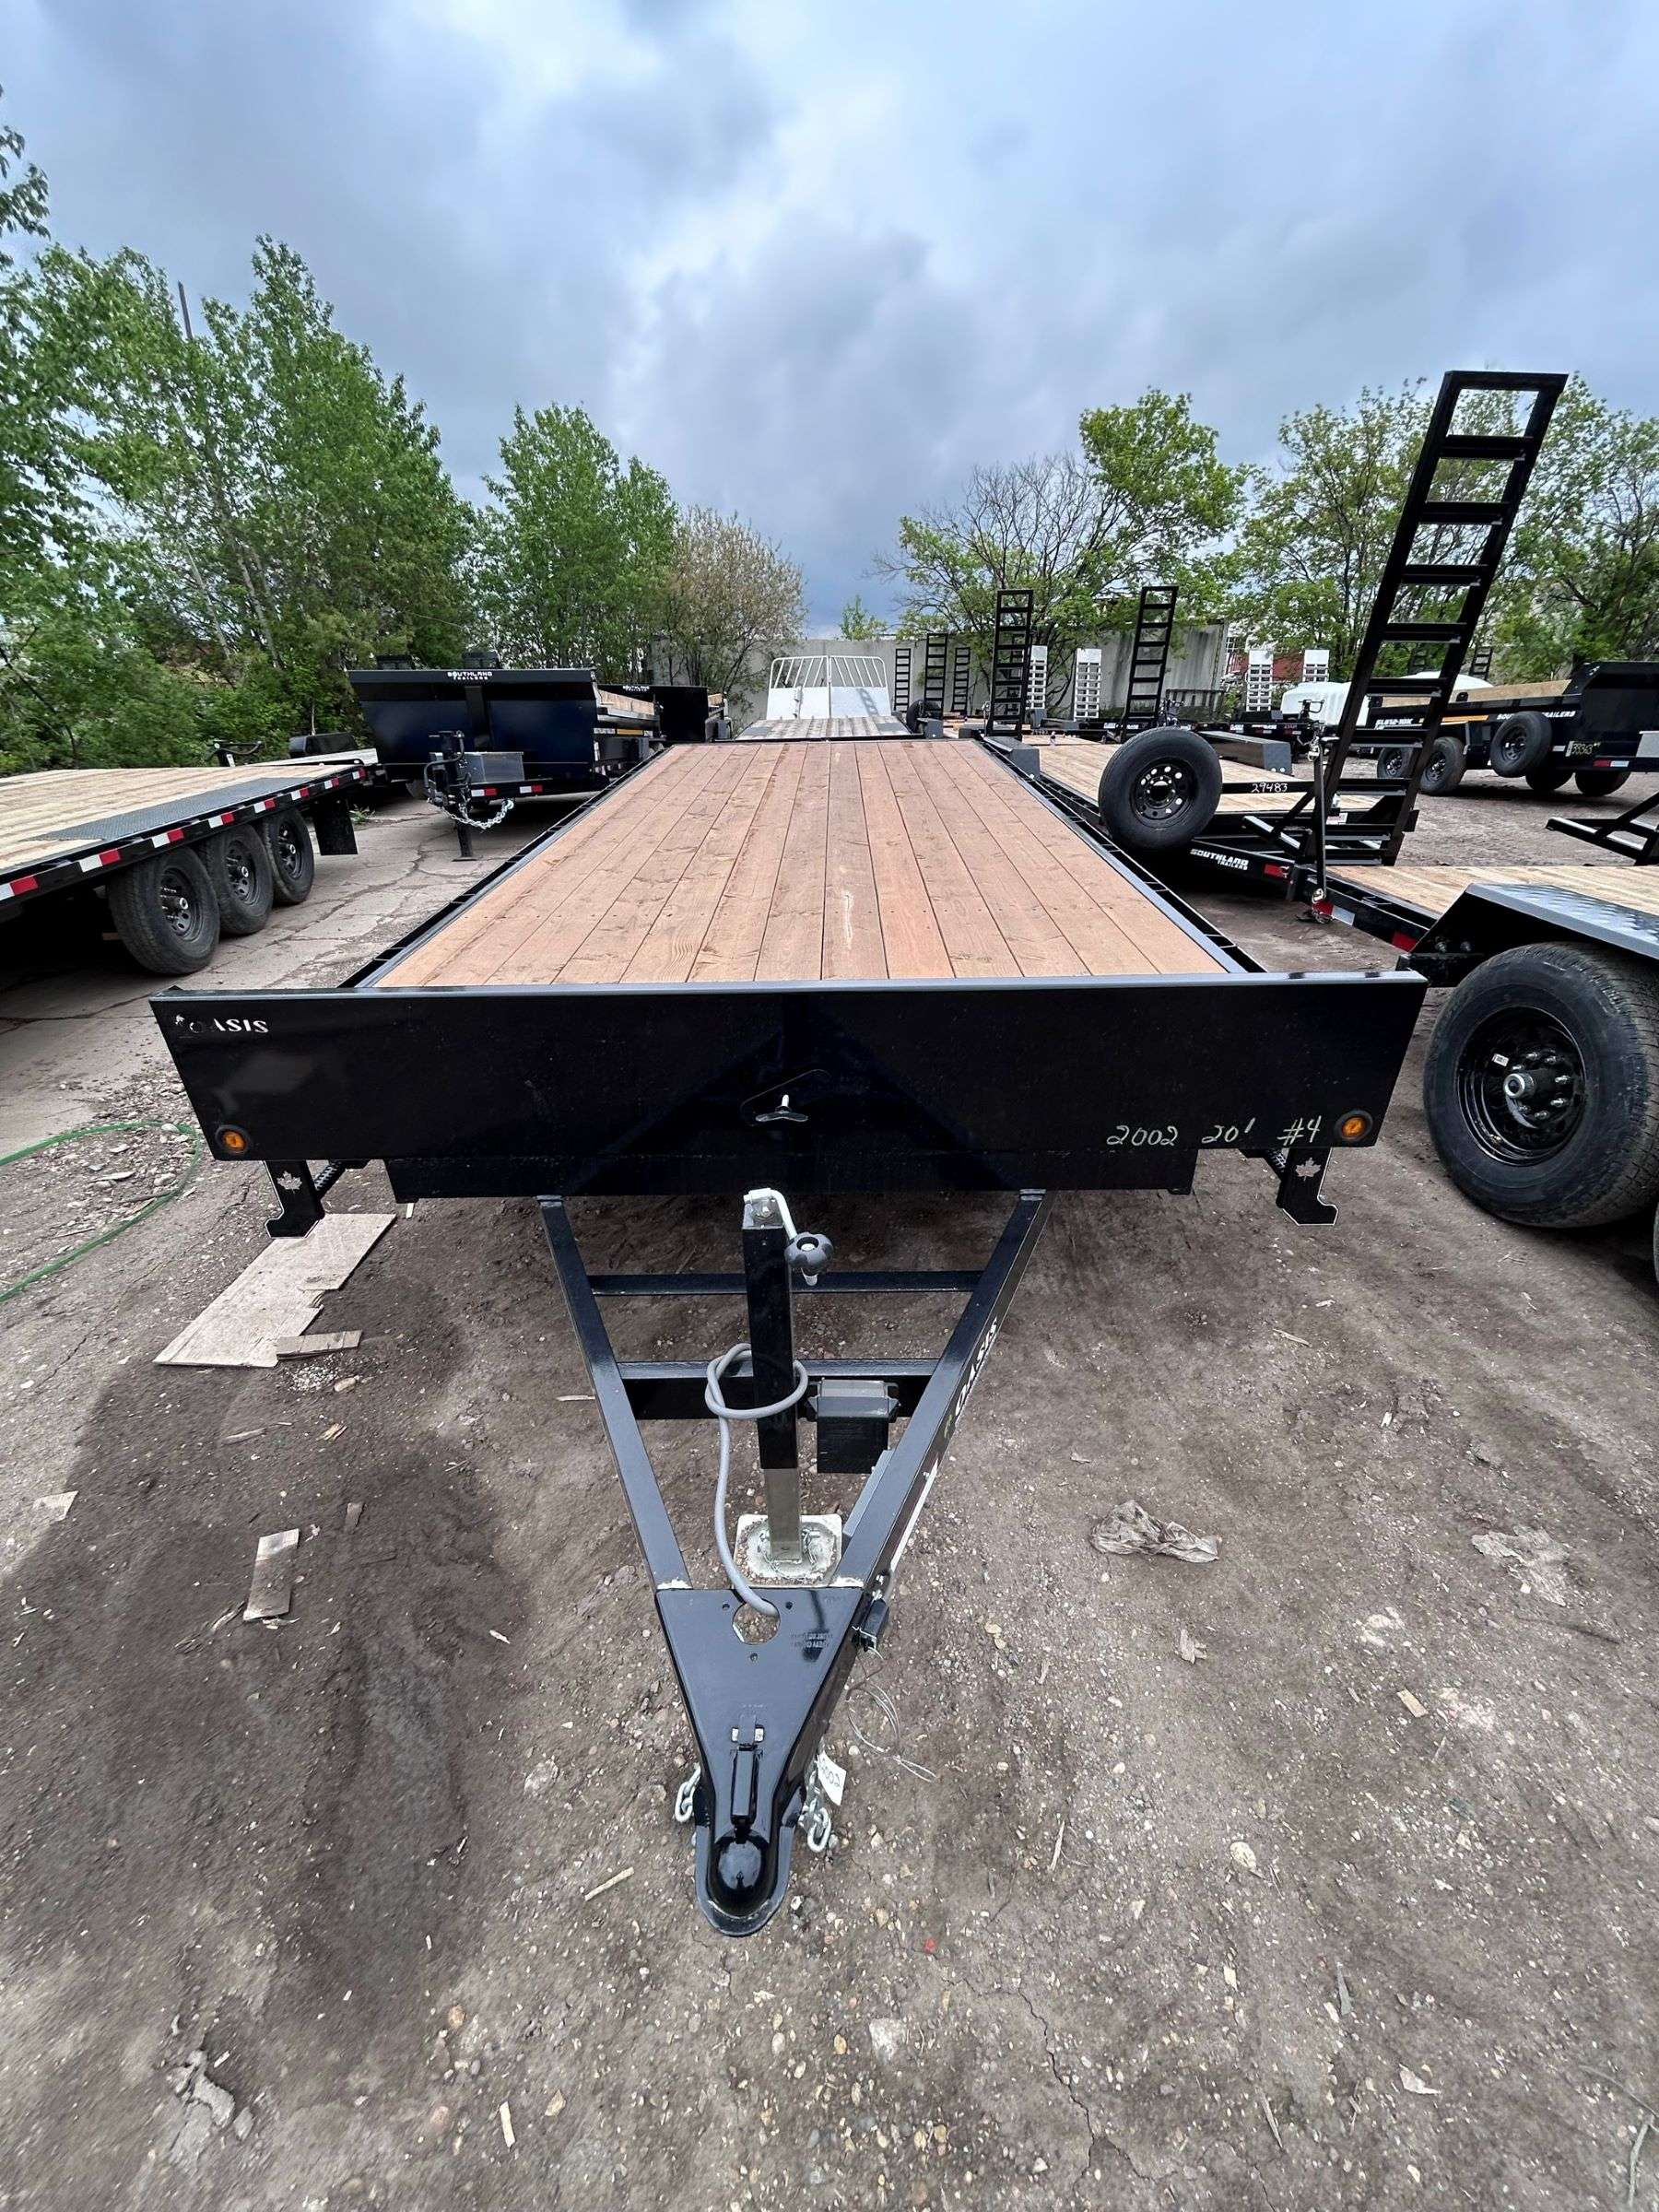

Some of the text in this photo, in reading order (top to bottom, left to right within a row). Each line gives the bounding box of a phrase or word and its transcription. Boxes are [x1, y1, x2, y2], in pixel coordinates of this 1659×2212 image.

[1252, 782, 1288, 794] 29483
[1190, 848, 1250, 866] SOUTHLAND
[1106, 1124, 1179, 1147] 2002
[1277, 1114, 1323, 1147] #4
